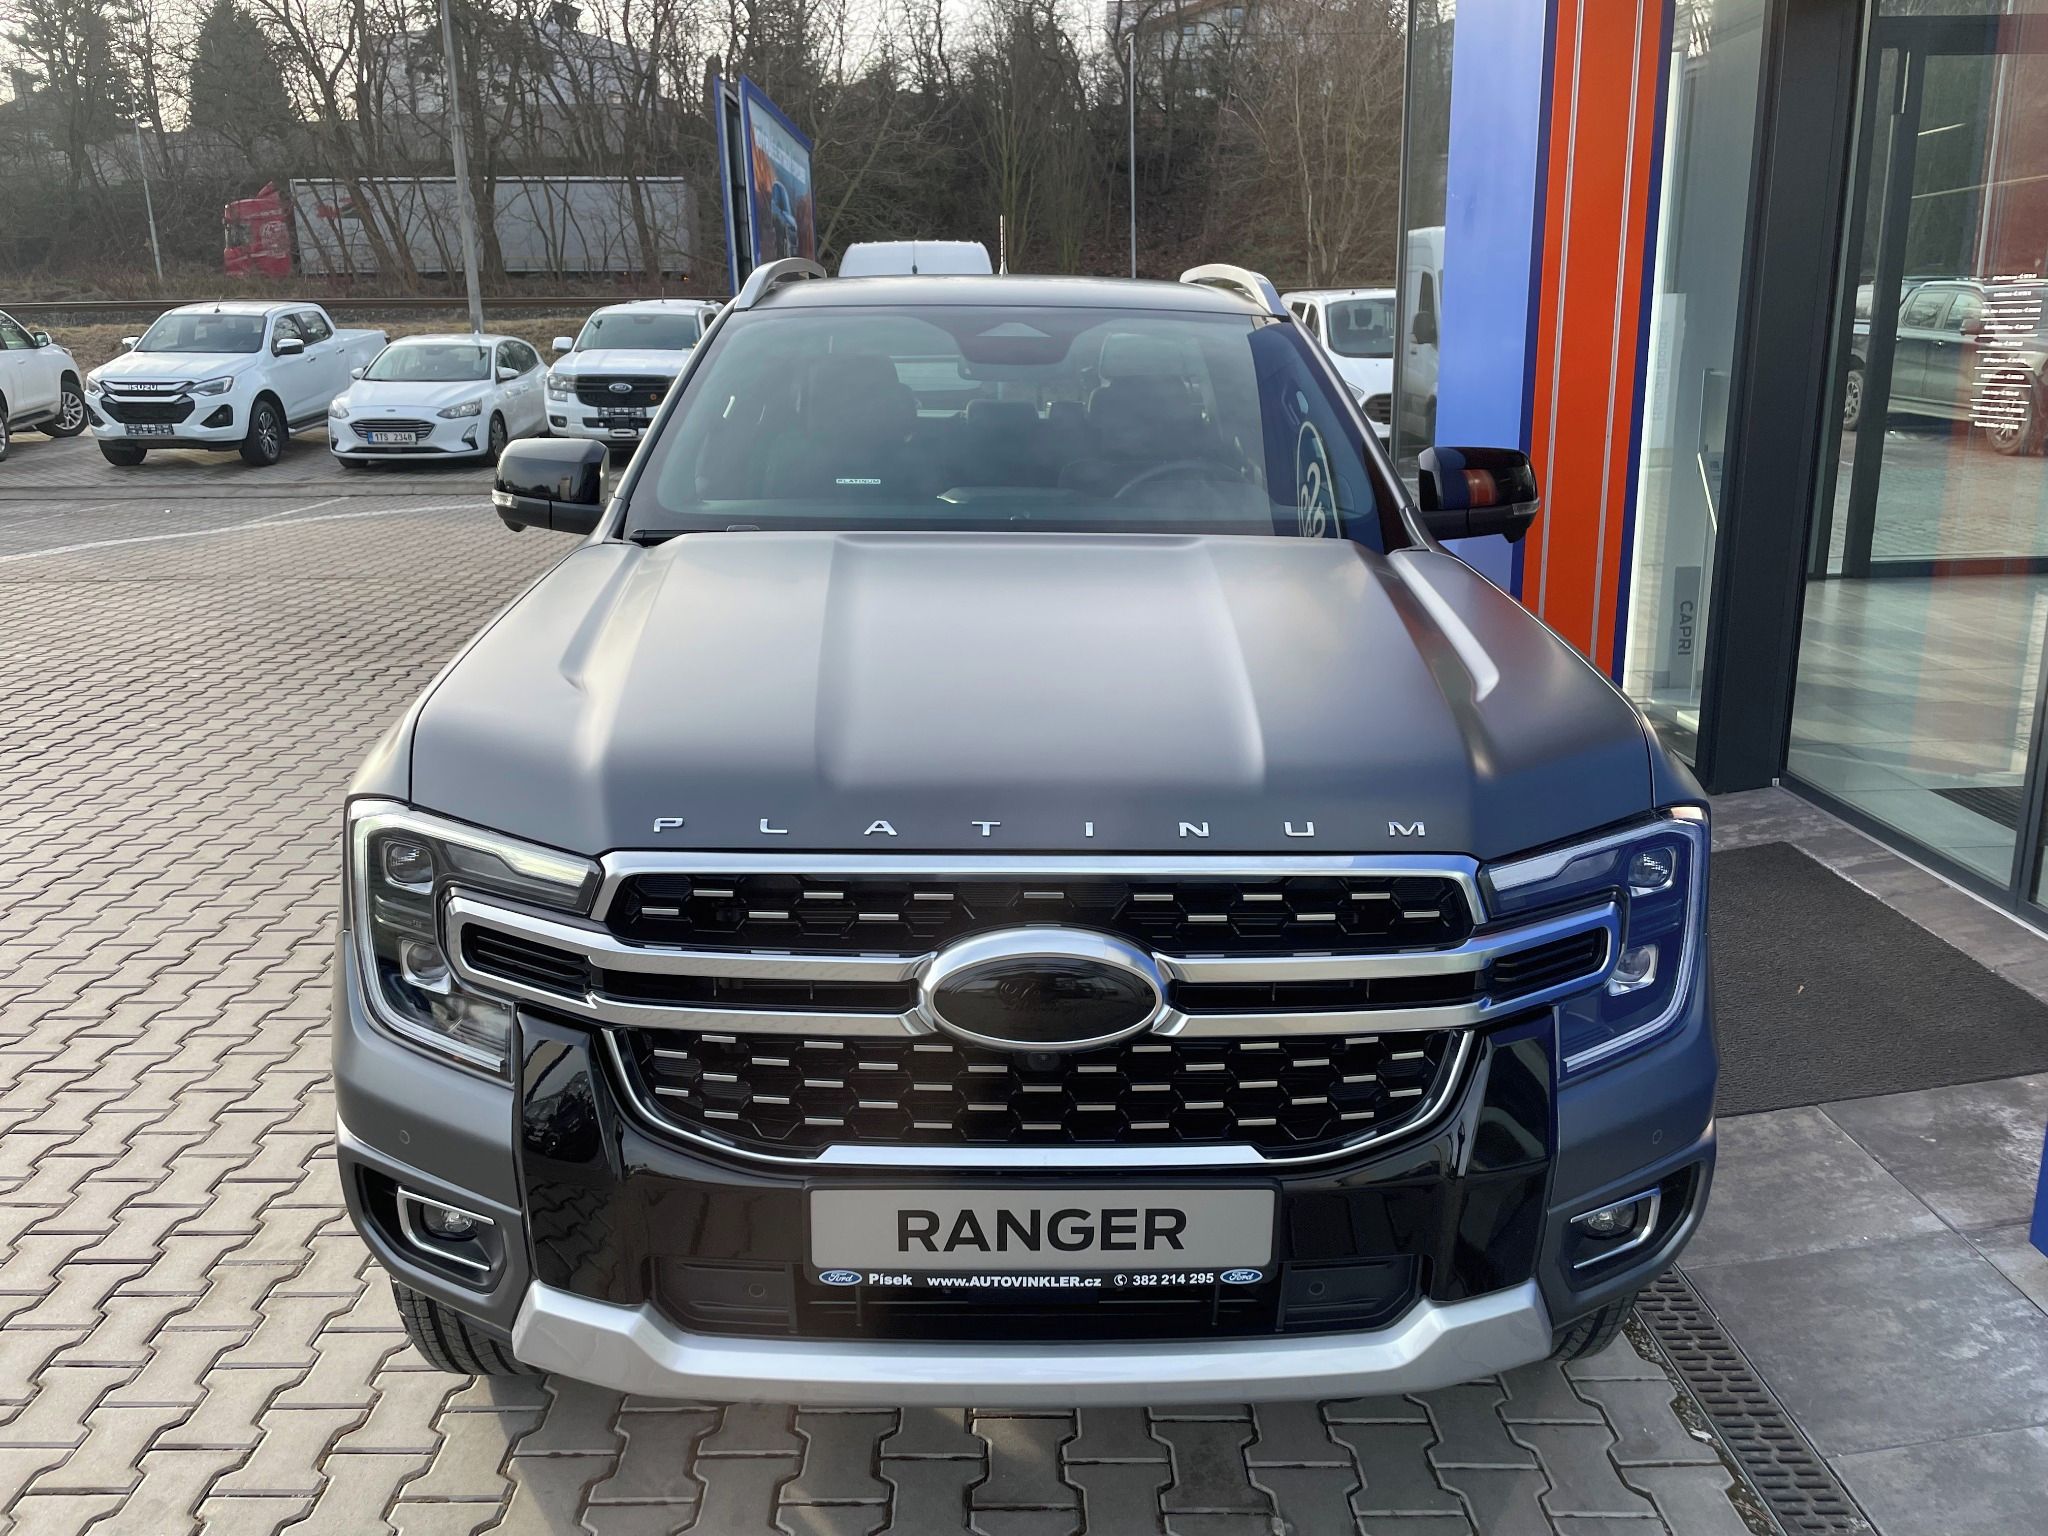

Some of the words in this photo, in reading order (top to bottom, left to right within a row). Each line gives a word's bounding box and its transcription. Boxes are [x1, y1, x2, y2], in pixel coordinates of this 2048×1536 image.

[1677, 600, 1694, 656] CAPRI
[653, 816, 1427, 838] PLATINUM
[896, 1207, 1188, 1253] RANGER
[868, 1273, 913, 1286] Písek
[926, 1275, 1102, 1288] www.AUTOVINKLER.cz
[1132, 1274, 1157, 1286] 382
[1160, 1273, 1186, 1285] 214
[1189, 1272, 1215, 1284] 295
